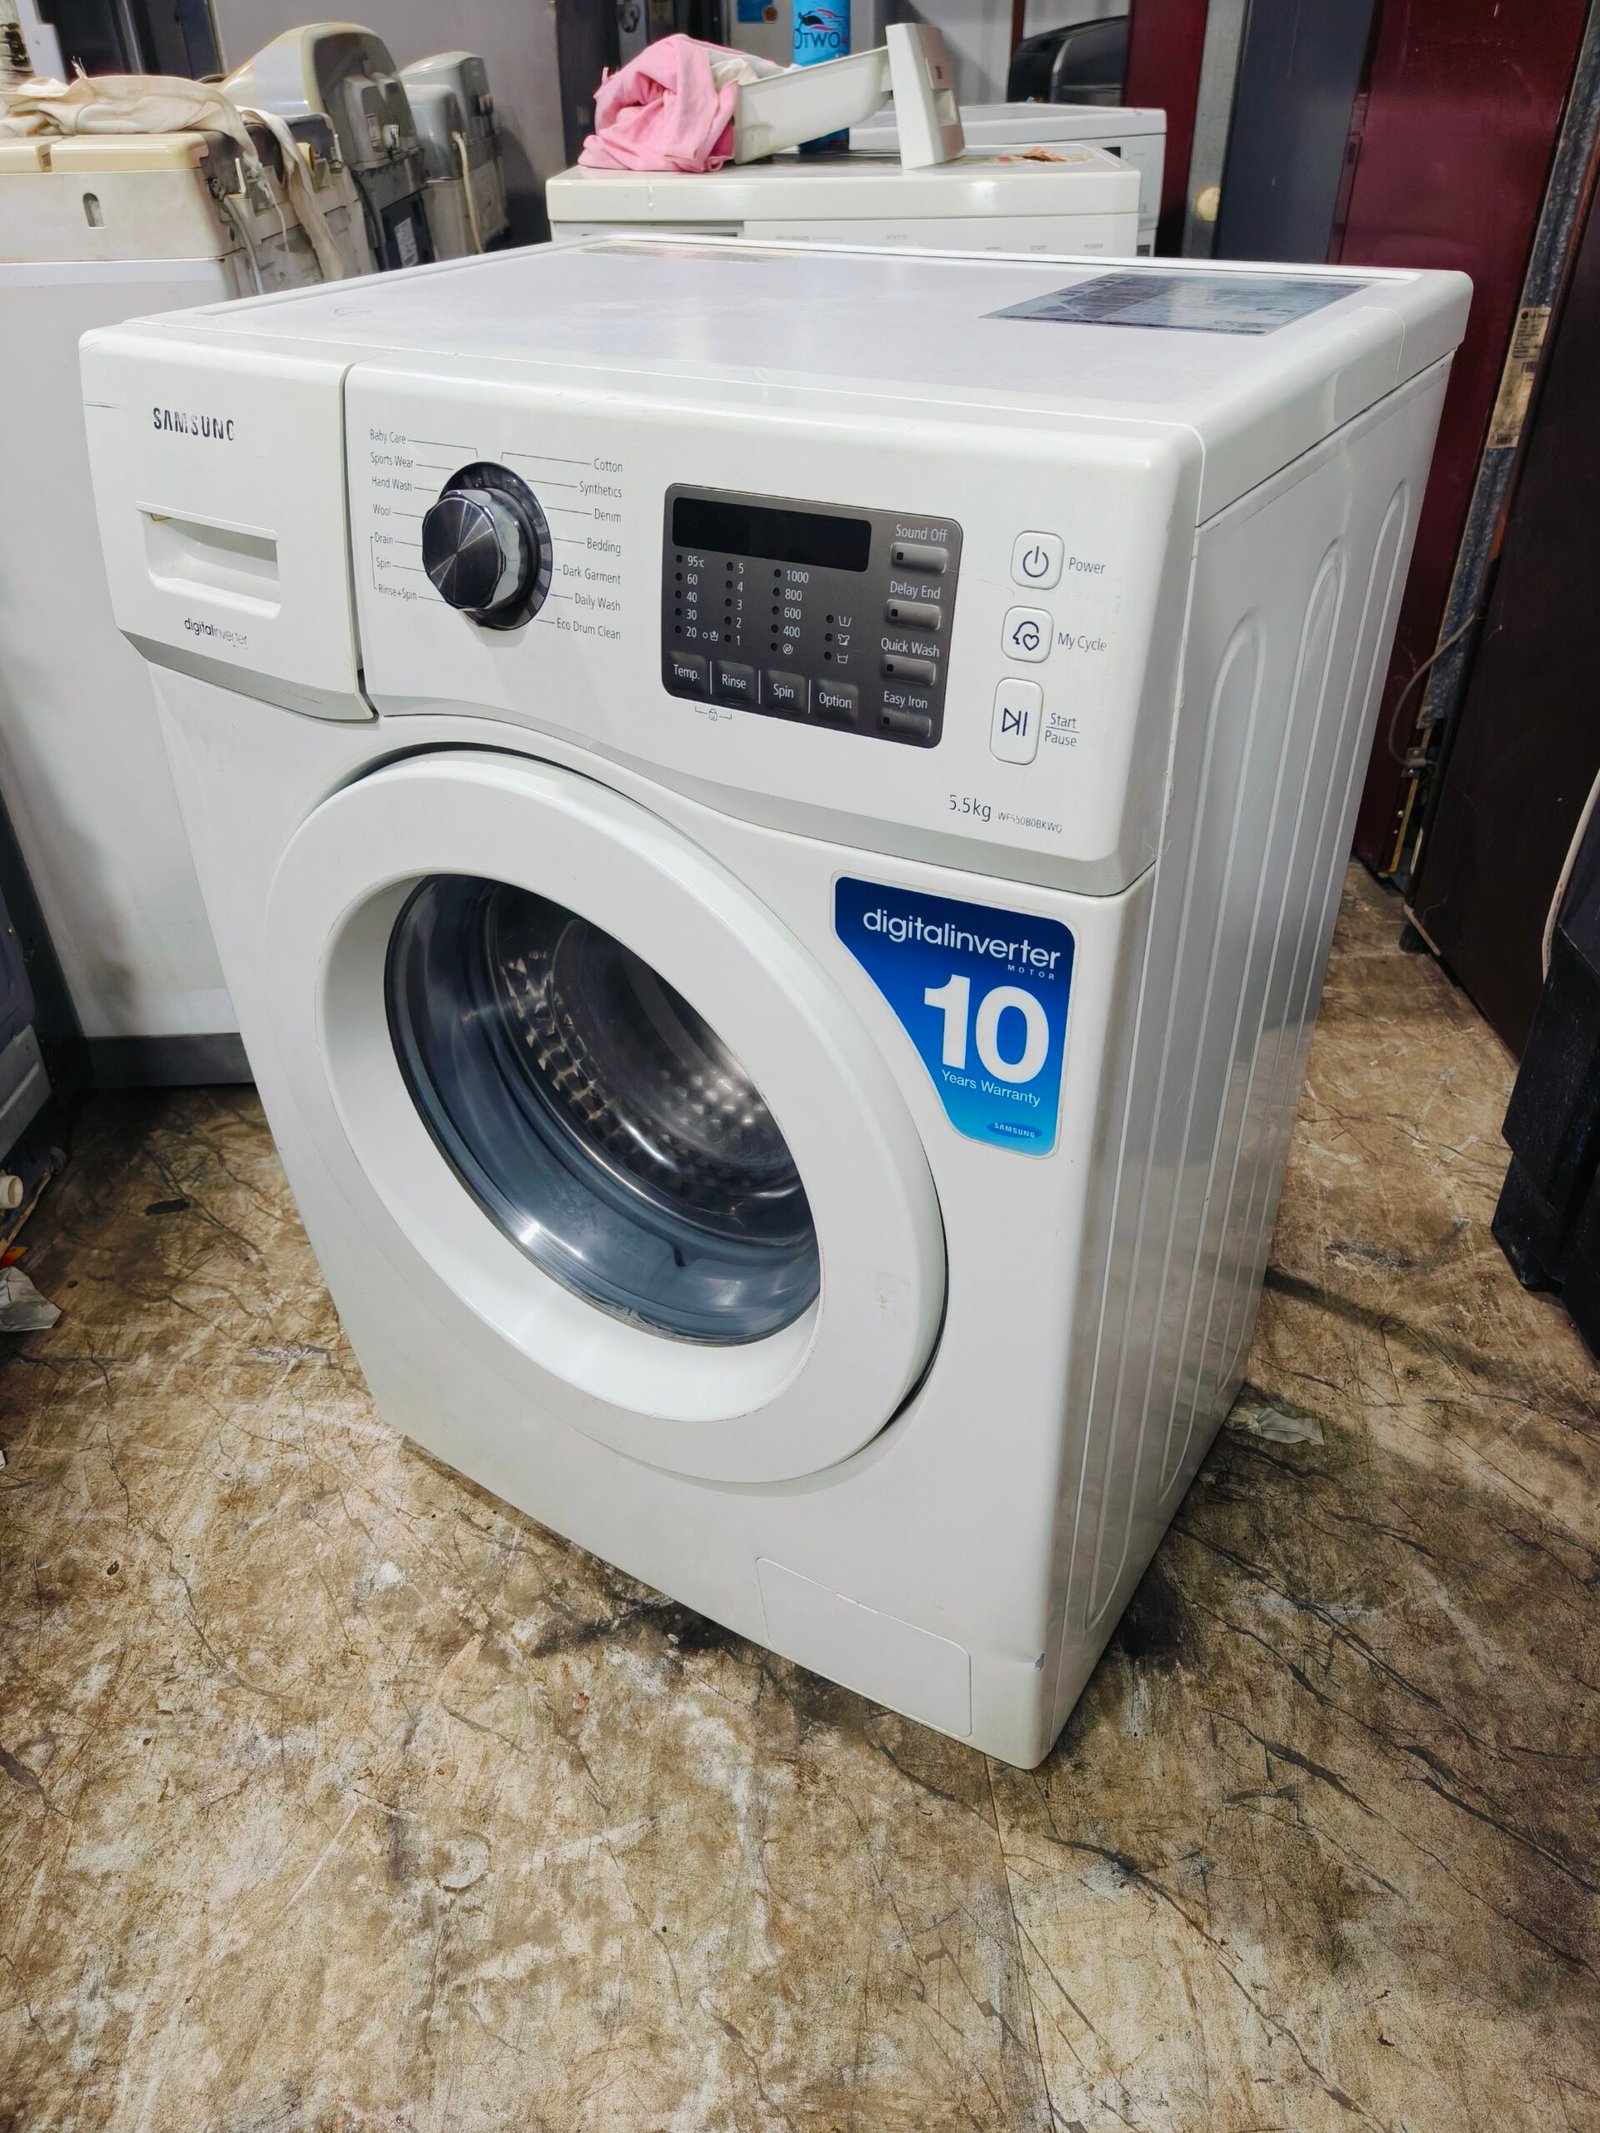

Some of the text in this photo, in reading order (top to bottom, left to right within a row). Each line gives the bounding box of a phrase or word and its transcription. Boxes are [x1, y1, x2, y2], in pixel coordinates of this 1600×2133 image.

[370, 429, 406, 444] Baby Care
[370, 452, 414, 469] Sports Wear
[593, 458, 623, 473] Cotton
[371, 476, 413, 491] Hand Wash
[579, 481, 623, 498] Synthetics
[373, 503, 391, 516] Wool
[593, 508, 621, 523] Denim
[374, 532, 394, 544] Drain
[895, 524, 948, 542] Sound Off
[586, 537, 621, 556] Bedding
[376, 556, 391, 570] Spin
[738, 563, 744, 574] 5
[1068, 556, 1106, 575] Power
[563, 564, 621, 585] Dark Garment
[687, 573, 698, 585] 60
[786, 571, 809, 584] 1000
[378, 583, 417, 601] Rinse+Spin
[737, 581, 743, 593] 4
[785, 589, 802, 601] 800
[890, 581, 941, 600] Delay End
[574, 593, 621, 611] Daily Wash
[686, 592, 697, 603] 40
[736, 599, 742, 610] 3
[686, 609, 697, 621] 30
[784, 608, 801, 620] 600
[556, 617, 621, 640] Eco Drum Clean
[736, 617, 742, 629] 2
[686, 626, 697, 638] 20
[736, 635, 741, 646] 1
[783, 626, 800, 638] 400
[881, 637, 940, 658] Quick Wash
[1058, 632, 1107, 653] My Cycle
[673, 664, 700, 682] Temp.
[721, 673, 746, 690] Rinse
[773, 683, 794, 698] Spin
[818, 692, 852, 710] Option
[883, 691, 928, 709] Easy Iron
[1050, 712, 1077, 729] Start
[1044, 730, 1077, 748] Pause
[949, 794, 991, 822] 5.5kg
[863, 908, 1060, 970] digitalinverter
[1007, 964, 1055, 980] MOTOR
[924, 973, 1050, 1084] 10
[941, 1069, 1041, 1108] Years Warranty
[994, 1122, 1035, 1139] SAMSUNG
